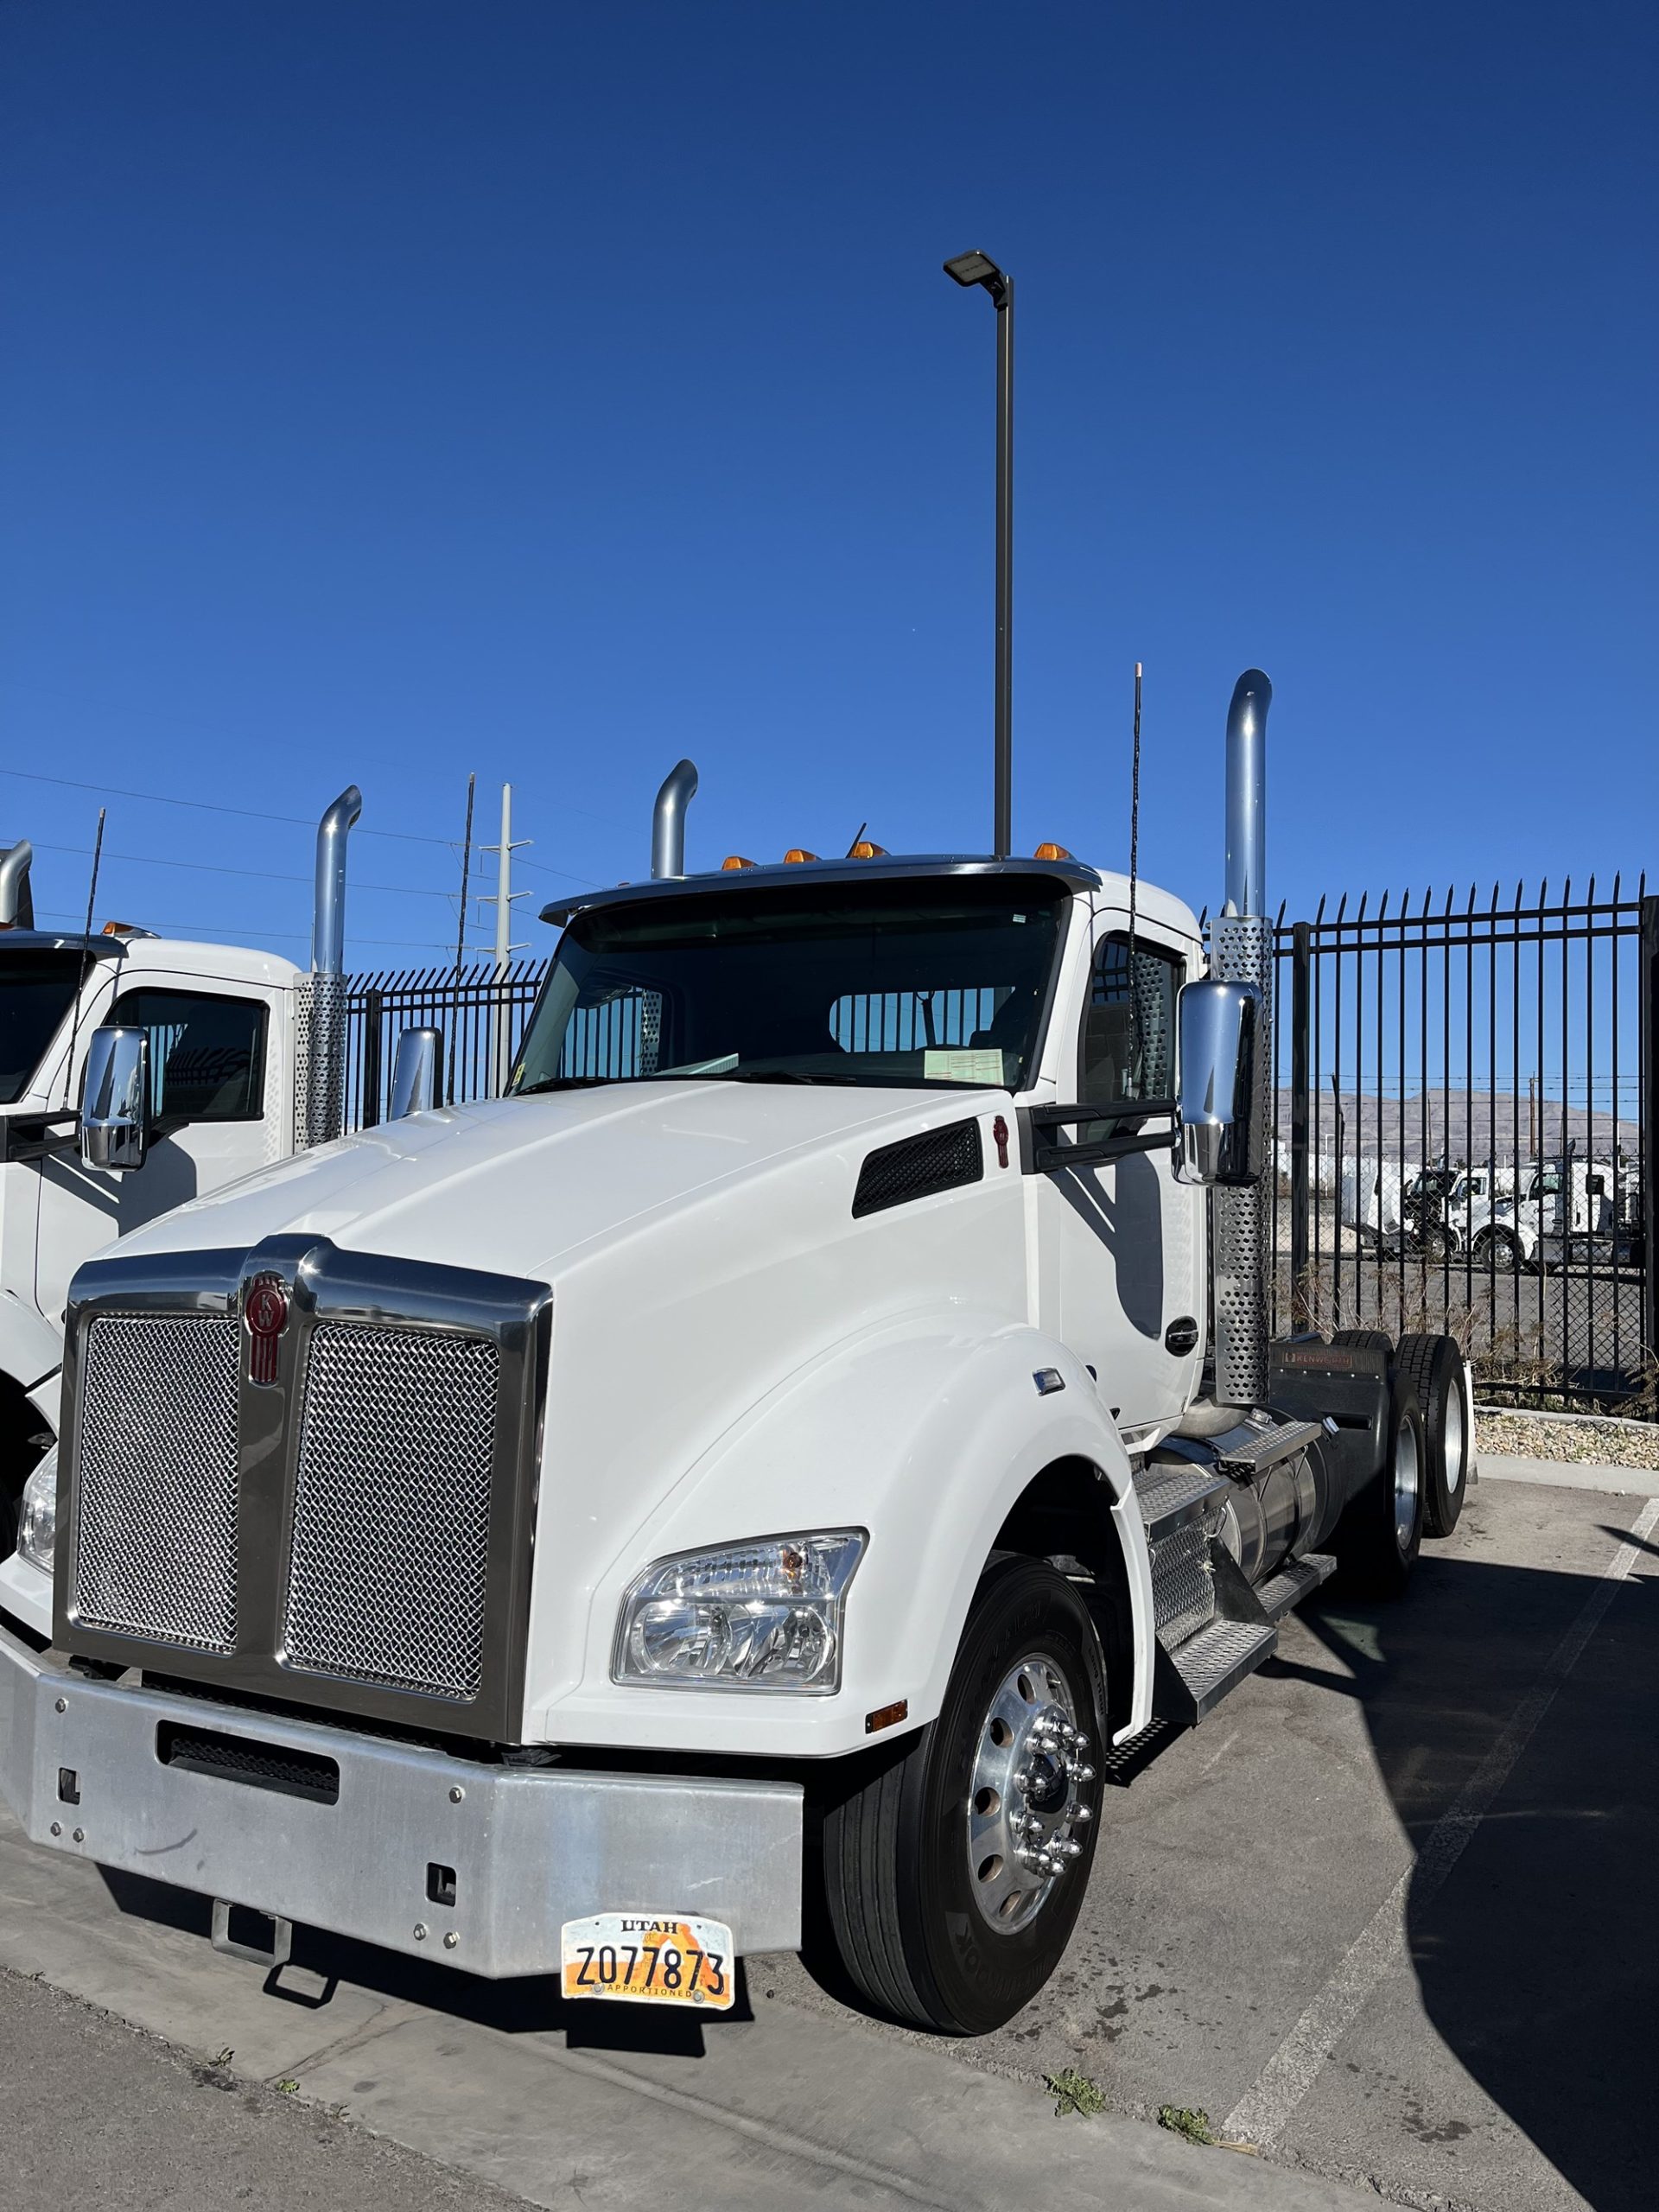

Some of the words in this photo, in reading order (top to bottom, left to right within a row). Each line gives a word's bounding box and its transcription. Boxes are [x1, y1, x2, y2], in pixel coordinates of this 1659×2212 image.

[620, 1919, 678, 1935] UTAH
[575, 1945, 725, 1996] Z077873
[607, 1985, 692, 1997] APPORTIONED
